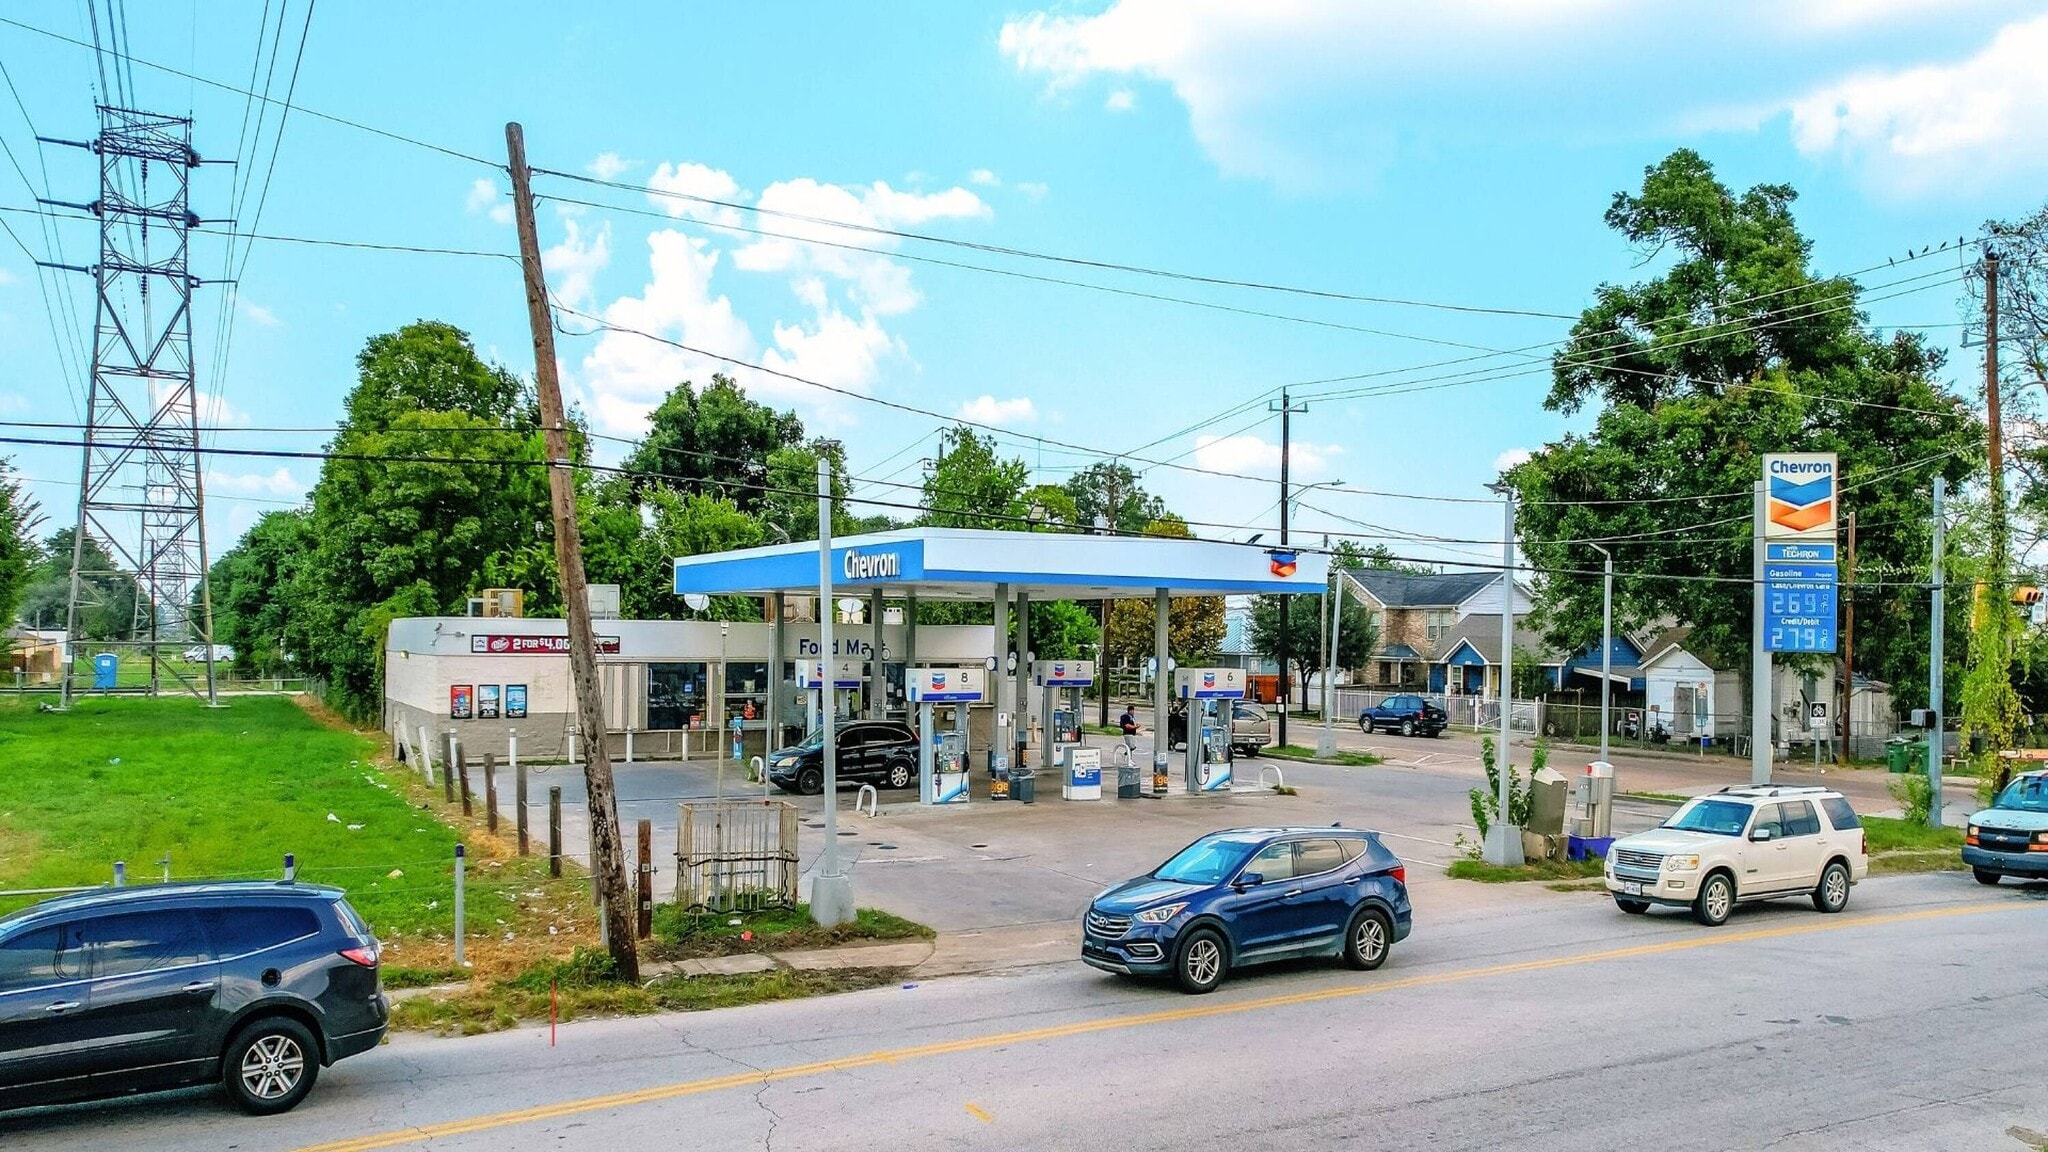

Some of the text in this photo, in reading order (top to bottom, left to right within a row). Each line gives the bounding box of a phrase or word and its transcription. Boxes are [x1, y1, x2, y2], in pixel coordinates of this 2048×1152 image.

[1770, 460, 1832, 474] Chevron
[1782, 549, 1820, 560] TECHRON
[844, 550, 897, 579] Chevron
[1769, 569, 1802, 577] Gasoline
[1781, 617, 1820, 626] Credit/Debit
[513, 638, 521, 649] 2
[522, 639, 538, 648] FOR
[799, 639, 839, 655] Fod
[842, 663, 849, 671] 4
[1076, 663, 1082, 672] 2
[961, 672, 969, 683] 8
[1227, 672, 1233, 681] 6
